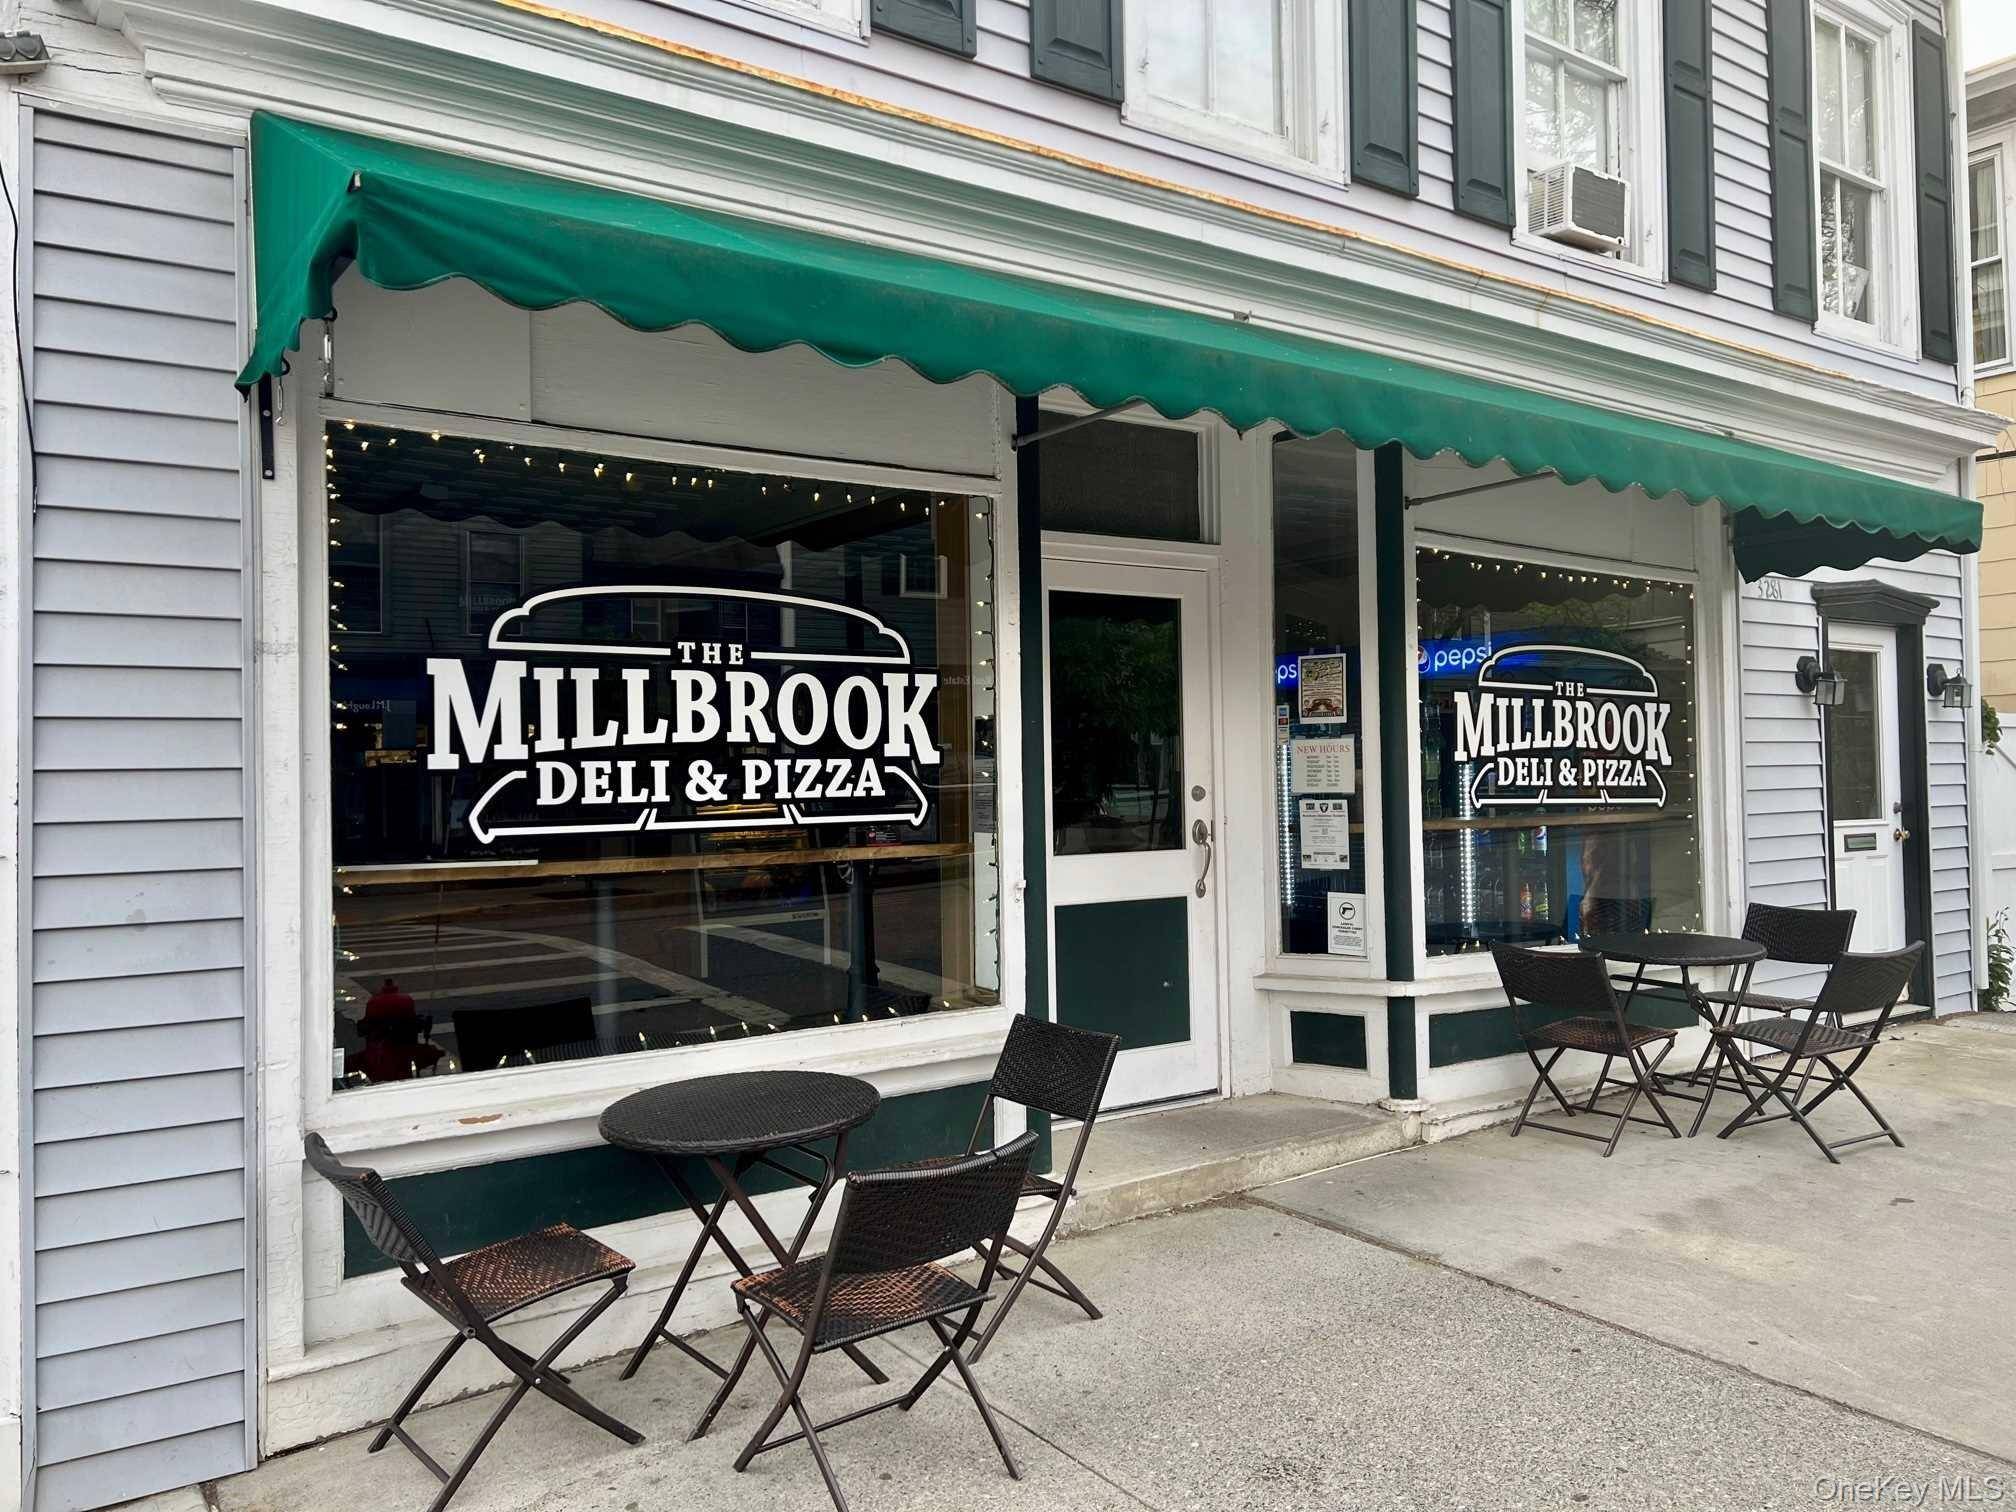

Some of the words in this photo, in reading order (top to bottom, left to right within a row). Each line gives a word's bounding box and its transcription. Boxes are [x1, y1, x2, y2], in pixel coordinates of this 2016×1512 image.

[677, 641, 744, 665] THE
[1434, 641, 1492, 672] pepsi
[1555, 681, 1584, 697] THE
[426, 657, 941, 770] MILLBROOK
[1453, 691, 1672, 766] MILLBROOK
[1296, 744, 1317, 754] NEW
[1319, 743, 1352, 754] HOURS
[535, 760, 671, 806] DELI
[684, 759, 728, 802] &
[741, 757, 886, 800] PIZZA
[1497, 757, 1554, 786] DELI
[1558, 758, 1578, 787] &
[1582, 758, 1647, 787] PIZZA
